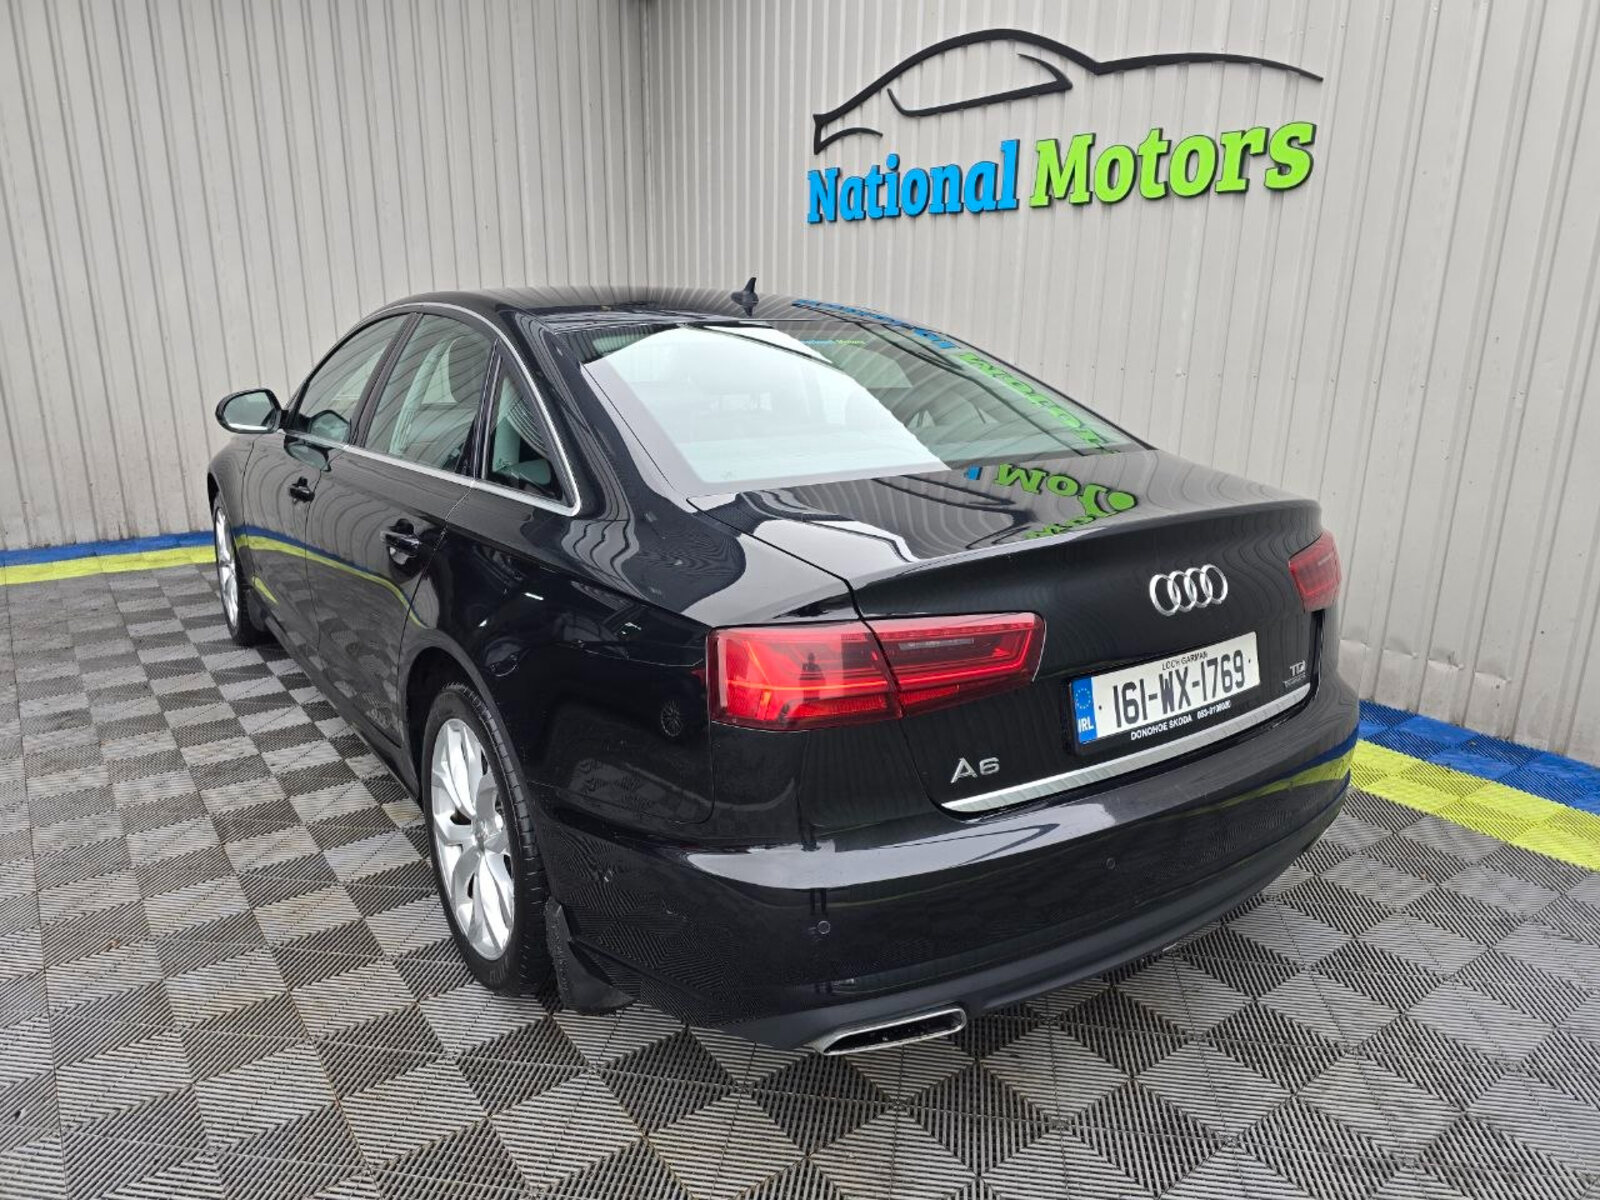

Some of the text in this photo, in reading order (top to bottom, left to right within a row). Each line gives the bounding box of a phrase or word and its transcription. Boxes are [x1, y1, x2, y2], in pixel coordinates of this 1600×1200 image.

[807, 121, 1317, 224] National Motors
[1112, 649, 1245, 728] 161-WX-1769
[1078, 716, 1095, 733] IRL
[1130, 722, 1168, 741] DONOHOE
[1168, 714, 1193, 730] SKODA
[950, 756, 1000, 784] A6
